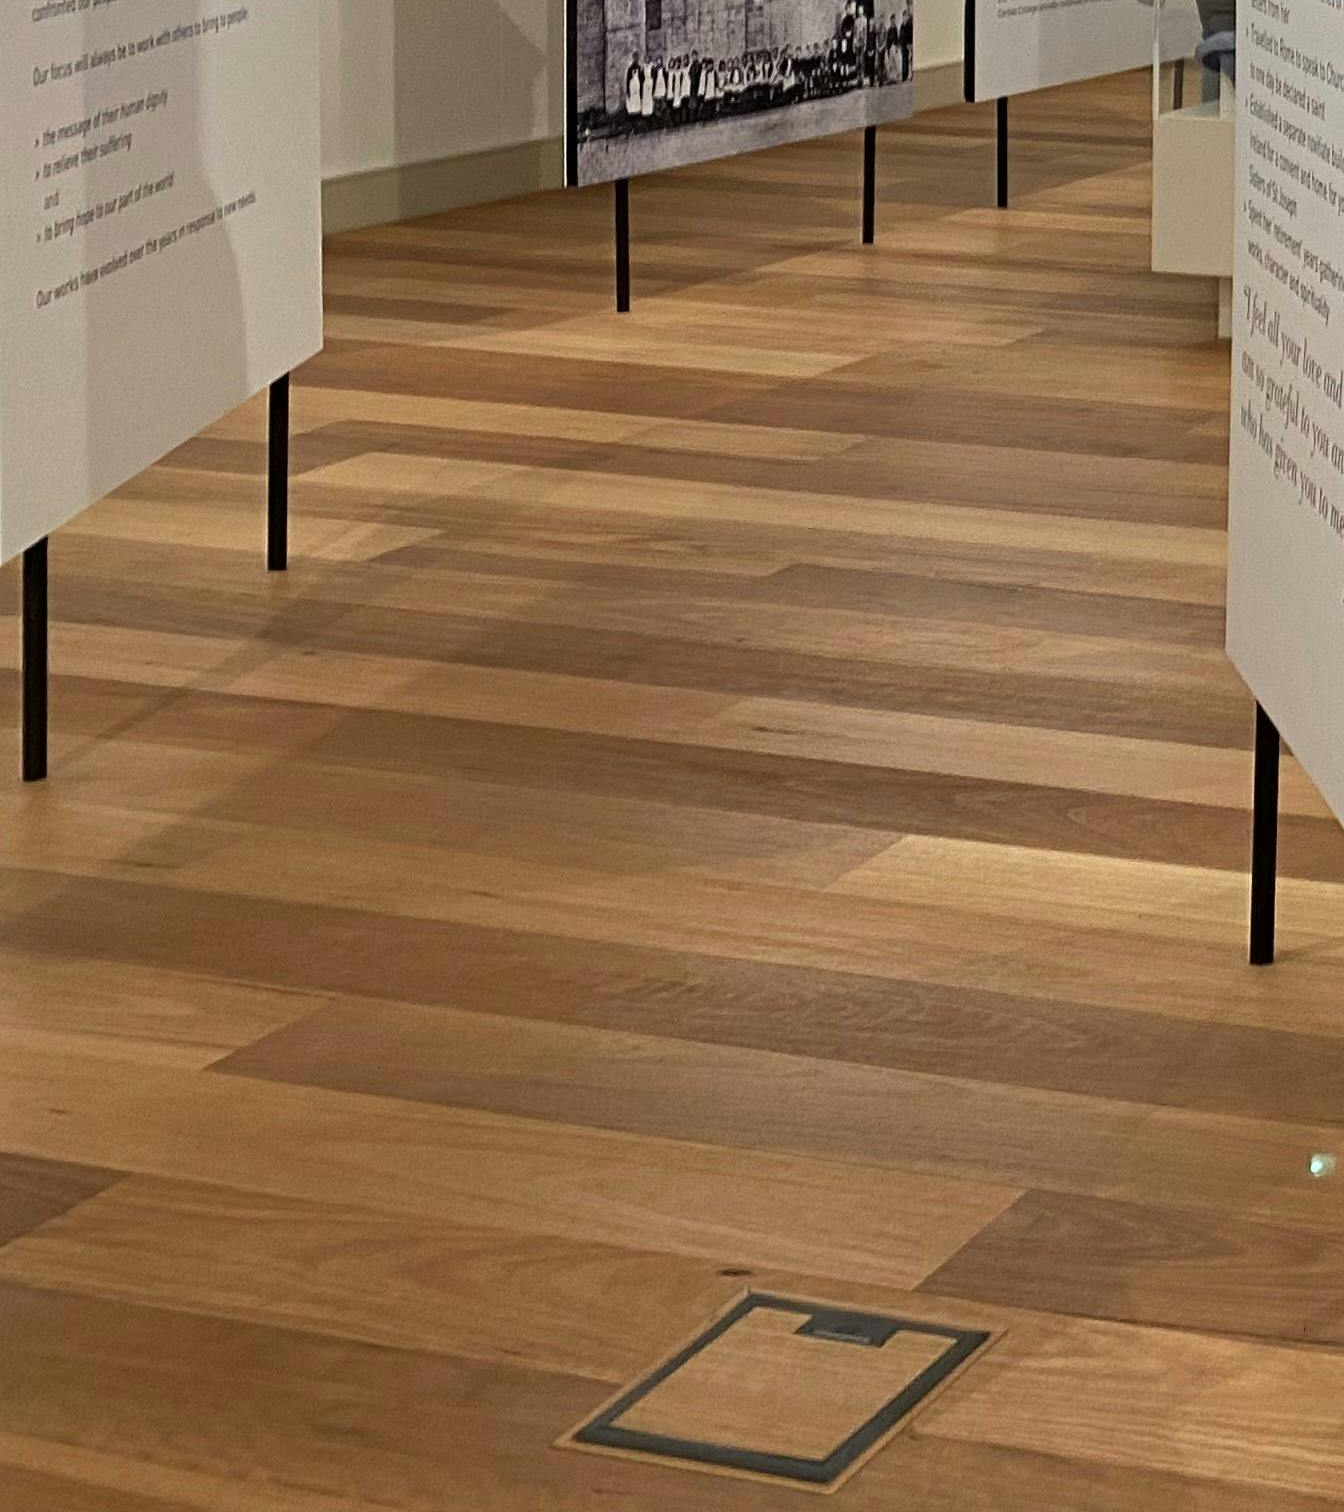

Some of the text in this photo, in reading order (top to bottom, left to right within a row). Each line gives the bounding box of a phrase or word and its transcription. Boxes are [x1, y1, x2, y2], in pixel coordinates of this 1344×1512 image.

[1241, 350, 1255, 381] am
[1255, 364, 1266, 393] so
[1264, 375, 1300, 431] grateful
[1300, 405, 1310, 440] to
[1310, 421, 1330, 460] you
[1249, 287, 1268, 338] feel
[1267, 311, 1281, 349] all
[1278, 313, 1302, 368] your
[1302, 336, 1323, 389] love
[1323, 369, 1344, 410] and
[1240, 399, 1258, 443] who
[1258, 411, 1274, 459] has
[1273, 435, 1298, 487] given
[1298, 469, 1317, 509] you
[1318, 486, 1329, 522] to
